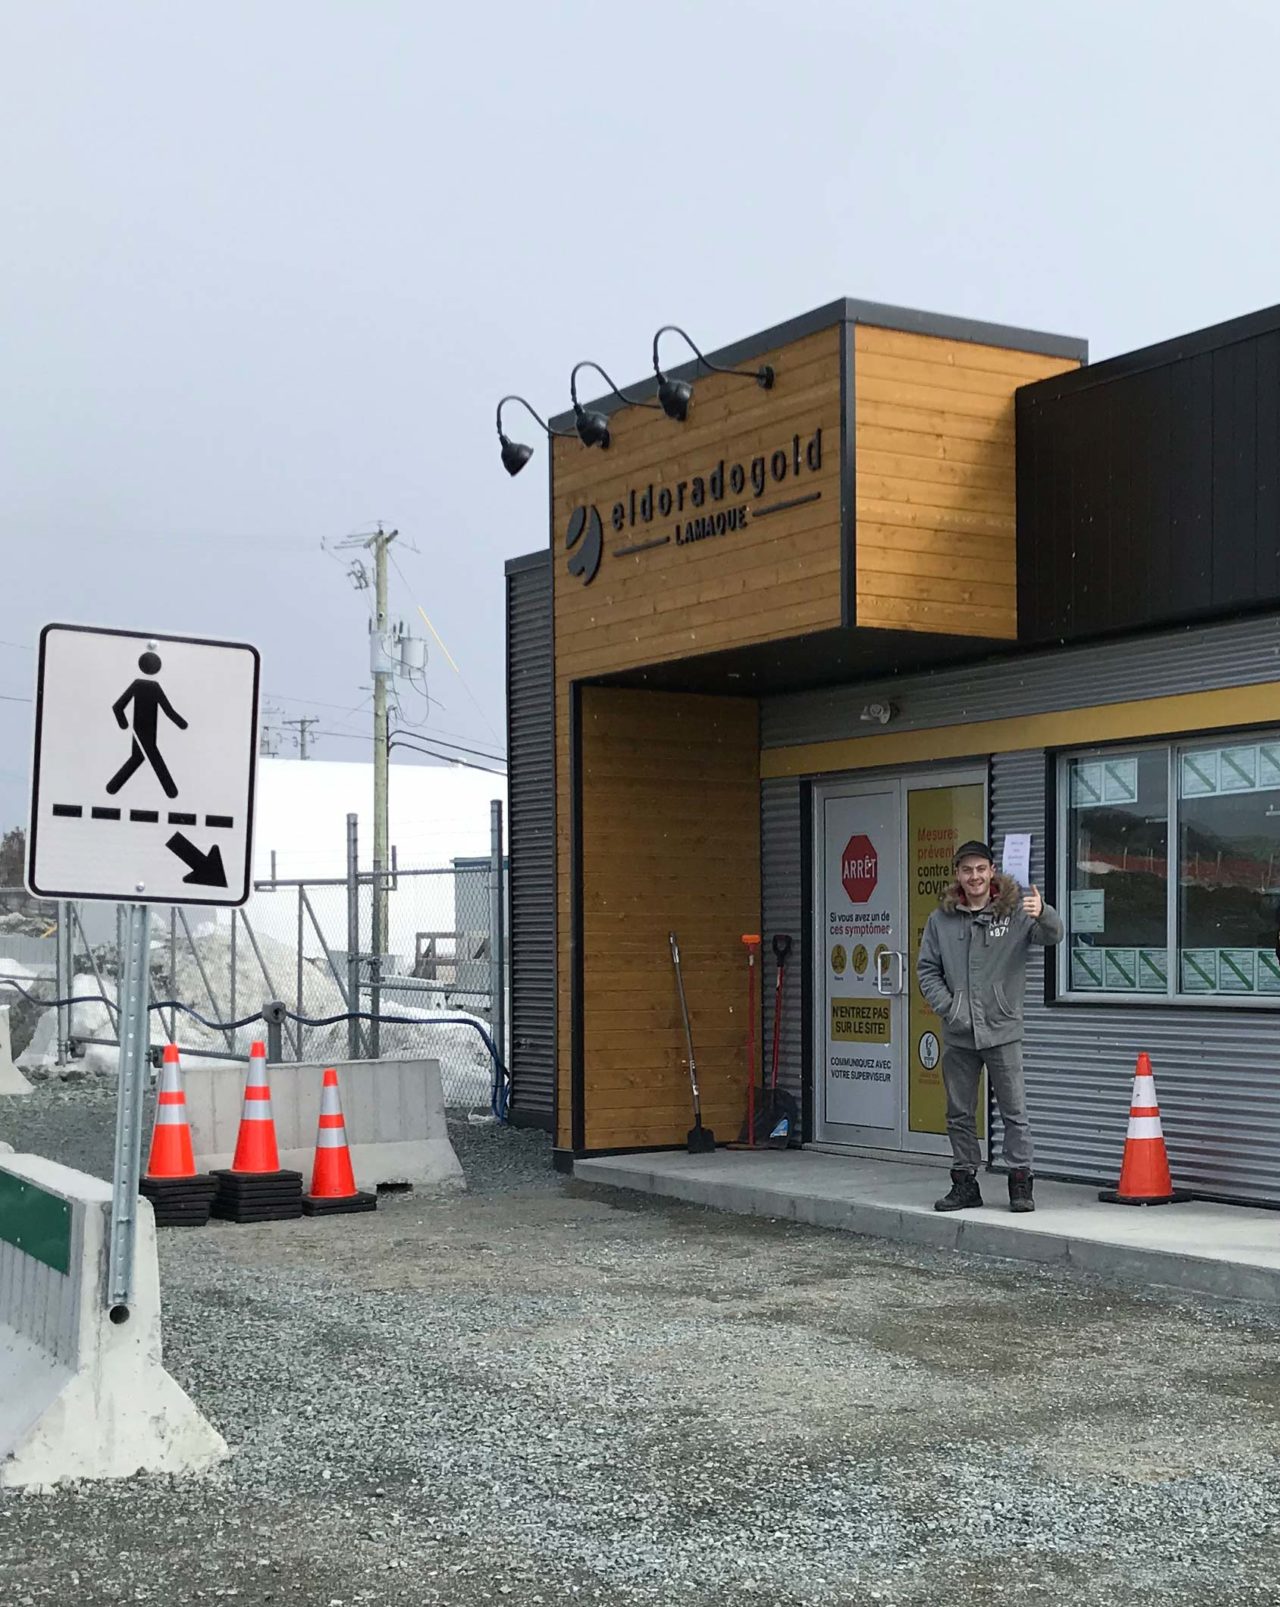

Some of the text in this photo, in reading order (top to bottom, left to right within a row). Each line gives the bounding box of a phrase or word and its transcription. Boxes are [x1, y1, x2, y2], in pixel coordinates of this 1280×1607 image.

[611, 427, 822, 531] eldoradogold
[675, 504, 748, 546] LAMAQUE
[918, 827, 958, 842] Mesures
[918, 844, 955, 860] prévent
[843, 855, 876, 879] ARRÊT
[918, 864, 949, 877] contre
[830, 910, 890, 922] Si vous avez un de
[830, 922, 890, 937] ces symptômes
[832, 1006, 889, 1019] N'ENTREZ PAS
[835, 1021, 852, 1033] SUR
[853, 1022, 864, 1034] LE
[831, 1057, 892, 1070] COMMUNIQUEZ AVEC
[831, 1070, 891, 1082] VOTRE SUPERVISEUR
